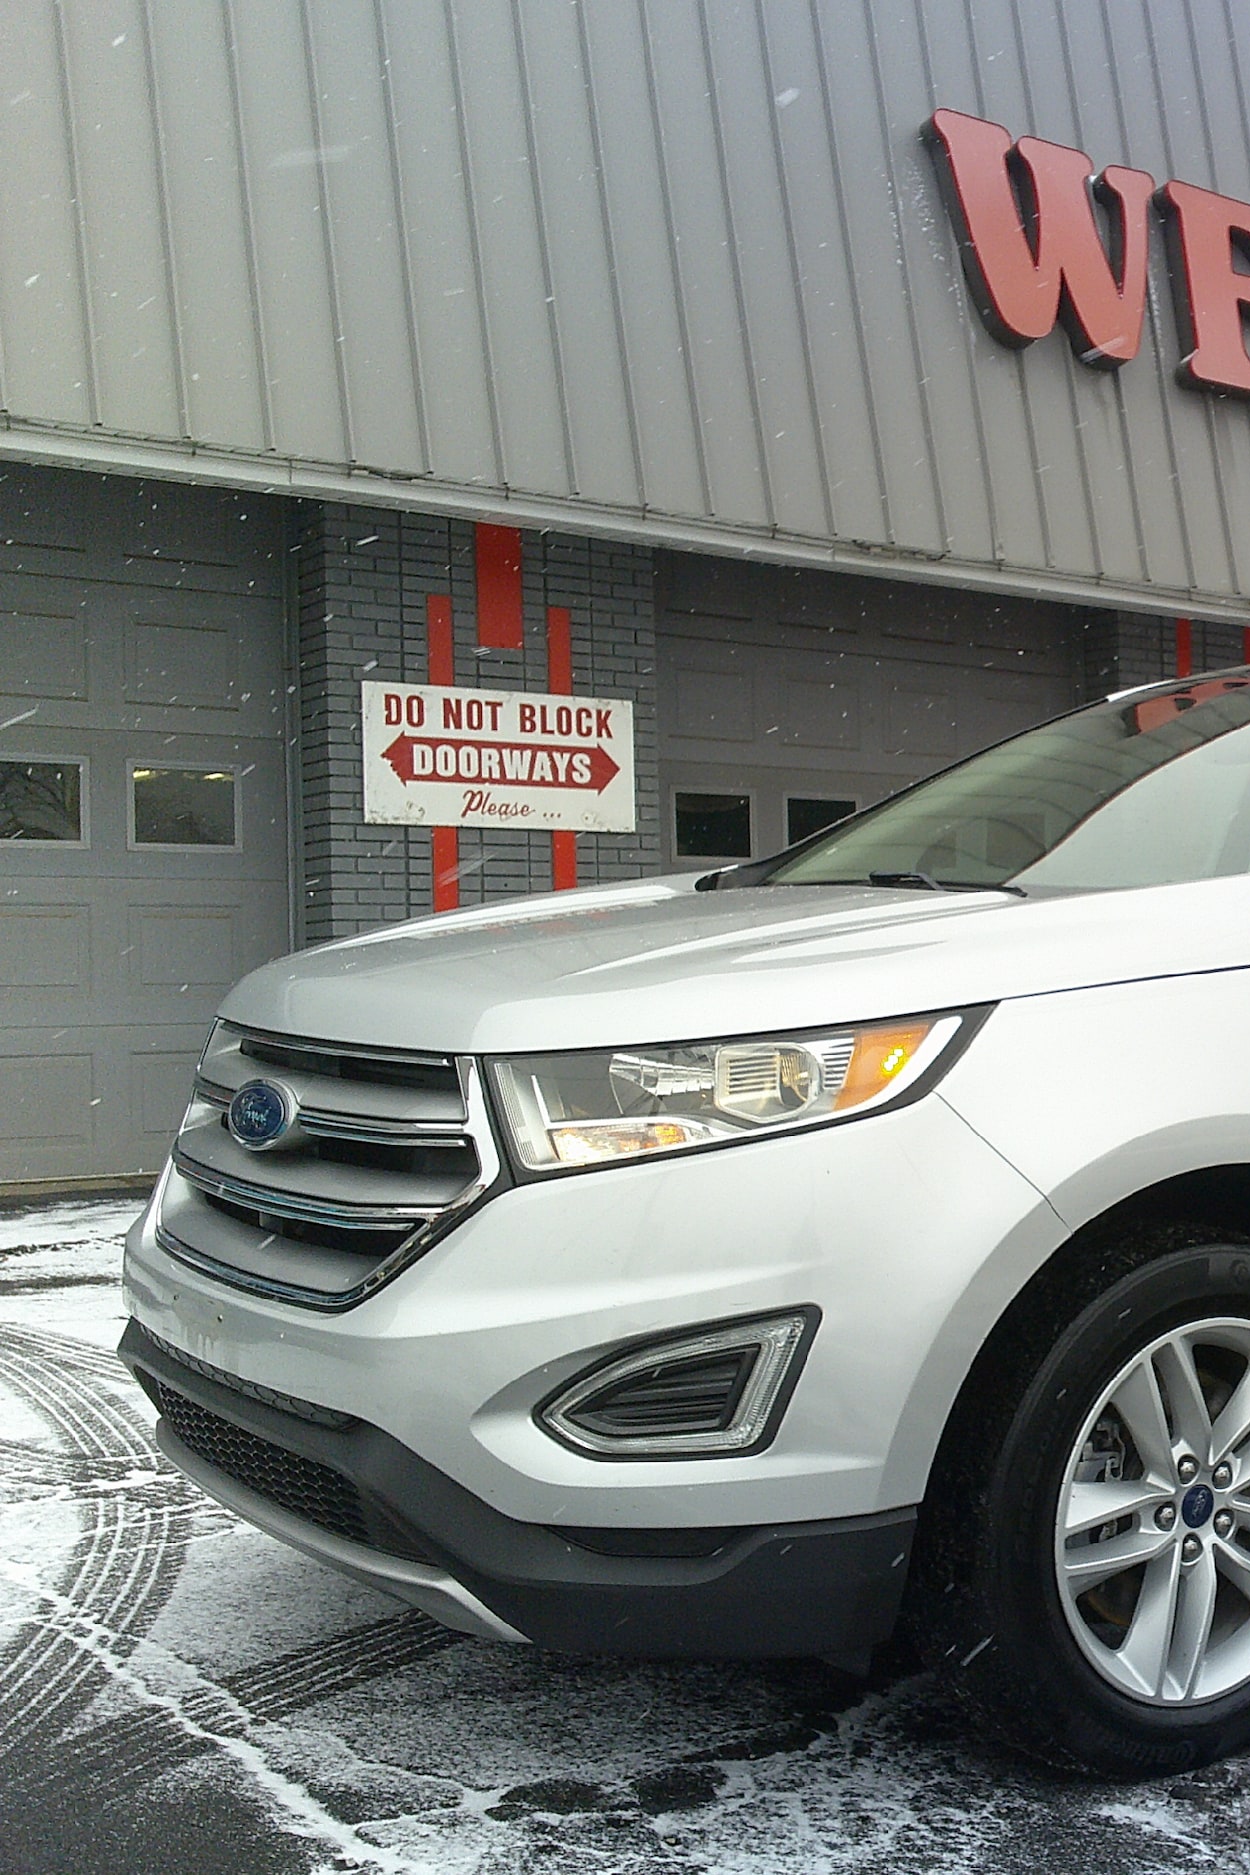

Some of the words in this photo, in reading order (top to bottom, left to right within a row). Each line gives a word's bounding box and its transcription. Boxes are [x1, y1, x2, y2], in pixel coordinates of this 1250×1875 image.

[384, 694, 424, 727] DO
[443, 697, 503, 731] NOT
[519, 703, 613, 739] BLOCK
[412, 743, 592, 784] DOORWAYS
[461, 790, 536, 818] Please
